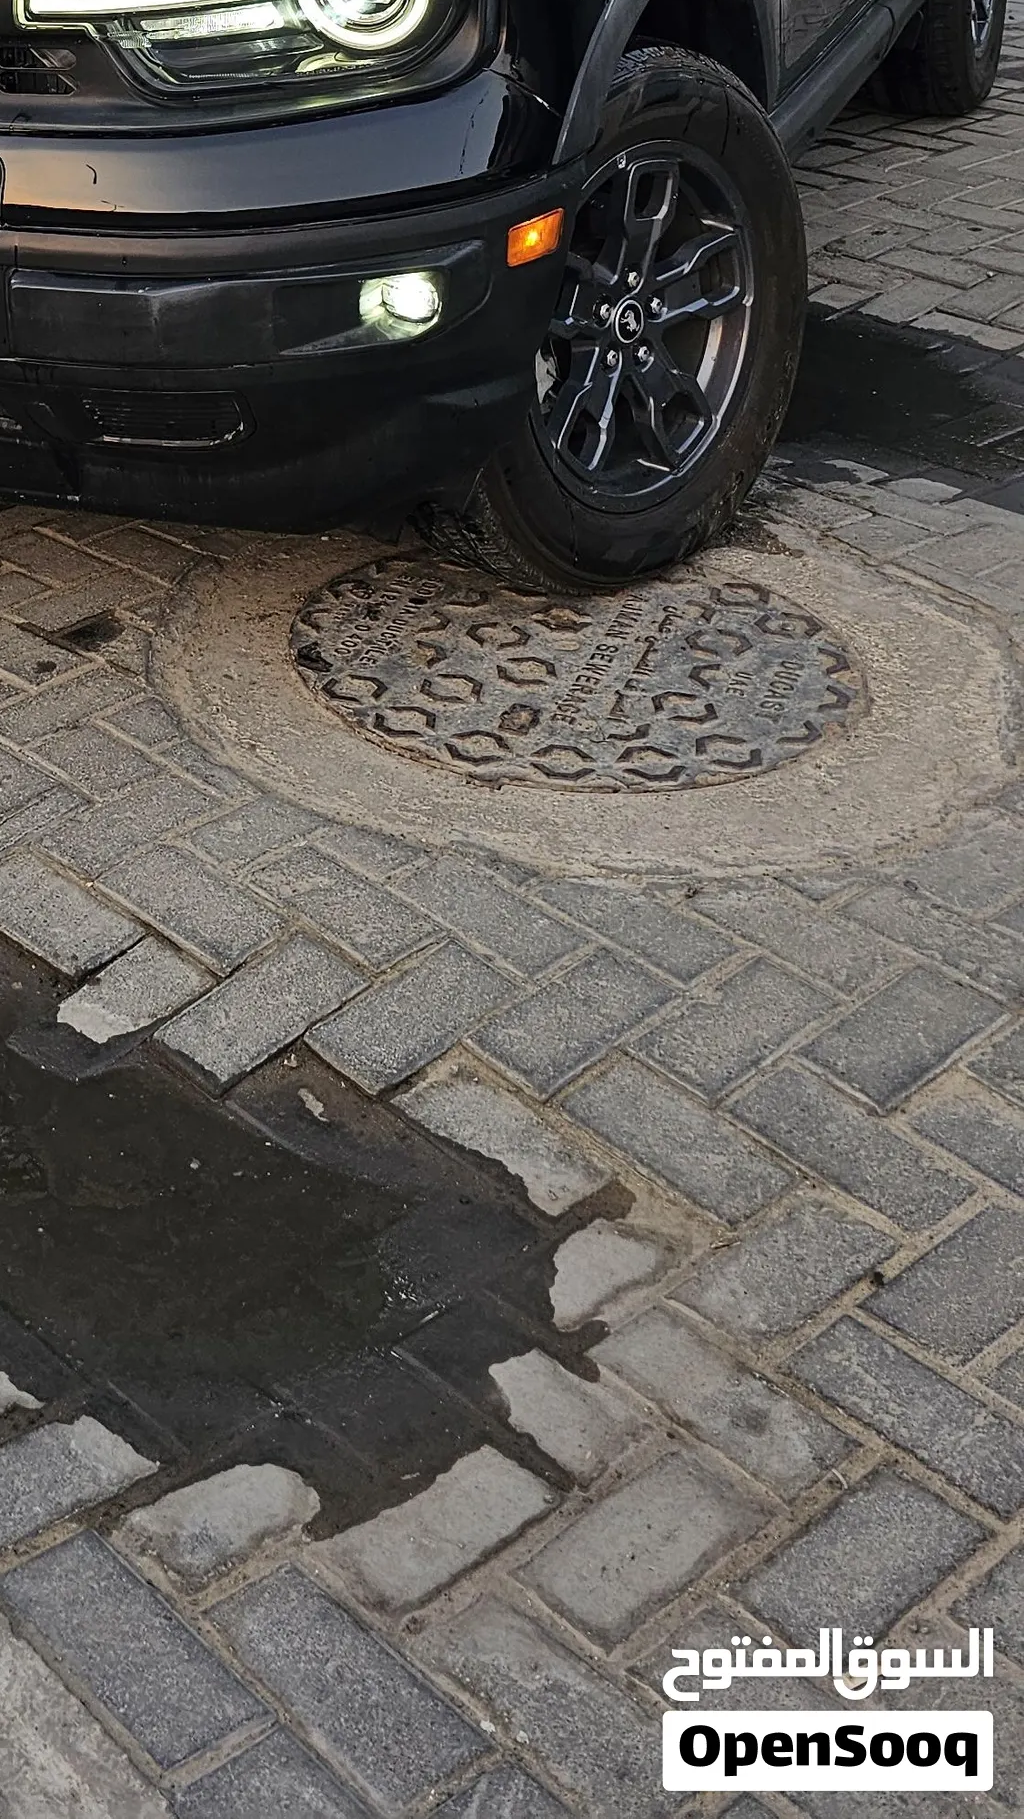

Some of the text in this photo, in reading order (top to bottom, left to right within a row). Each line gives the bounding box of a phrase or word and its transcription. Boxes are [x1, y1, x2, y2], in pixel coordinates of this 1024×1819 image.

[549, 594, 649, 725] AJMAN SEWERAGE
[726, 671, 756, 697] UAE
[754, 660, 806, 724] DUCAST
